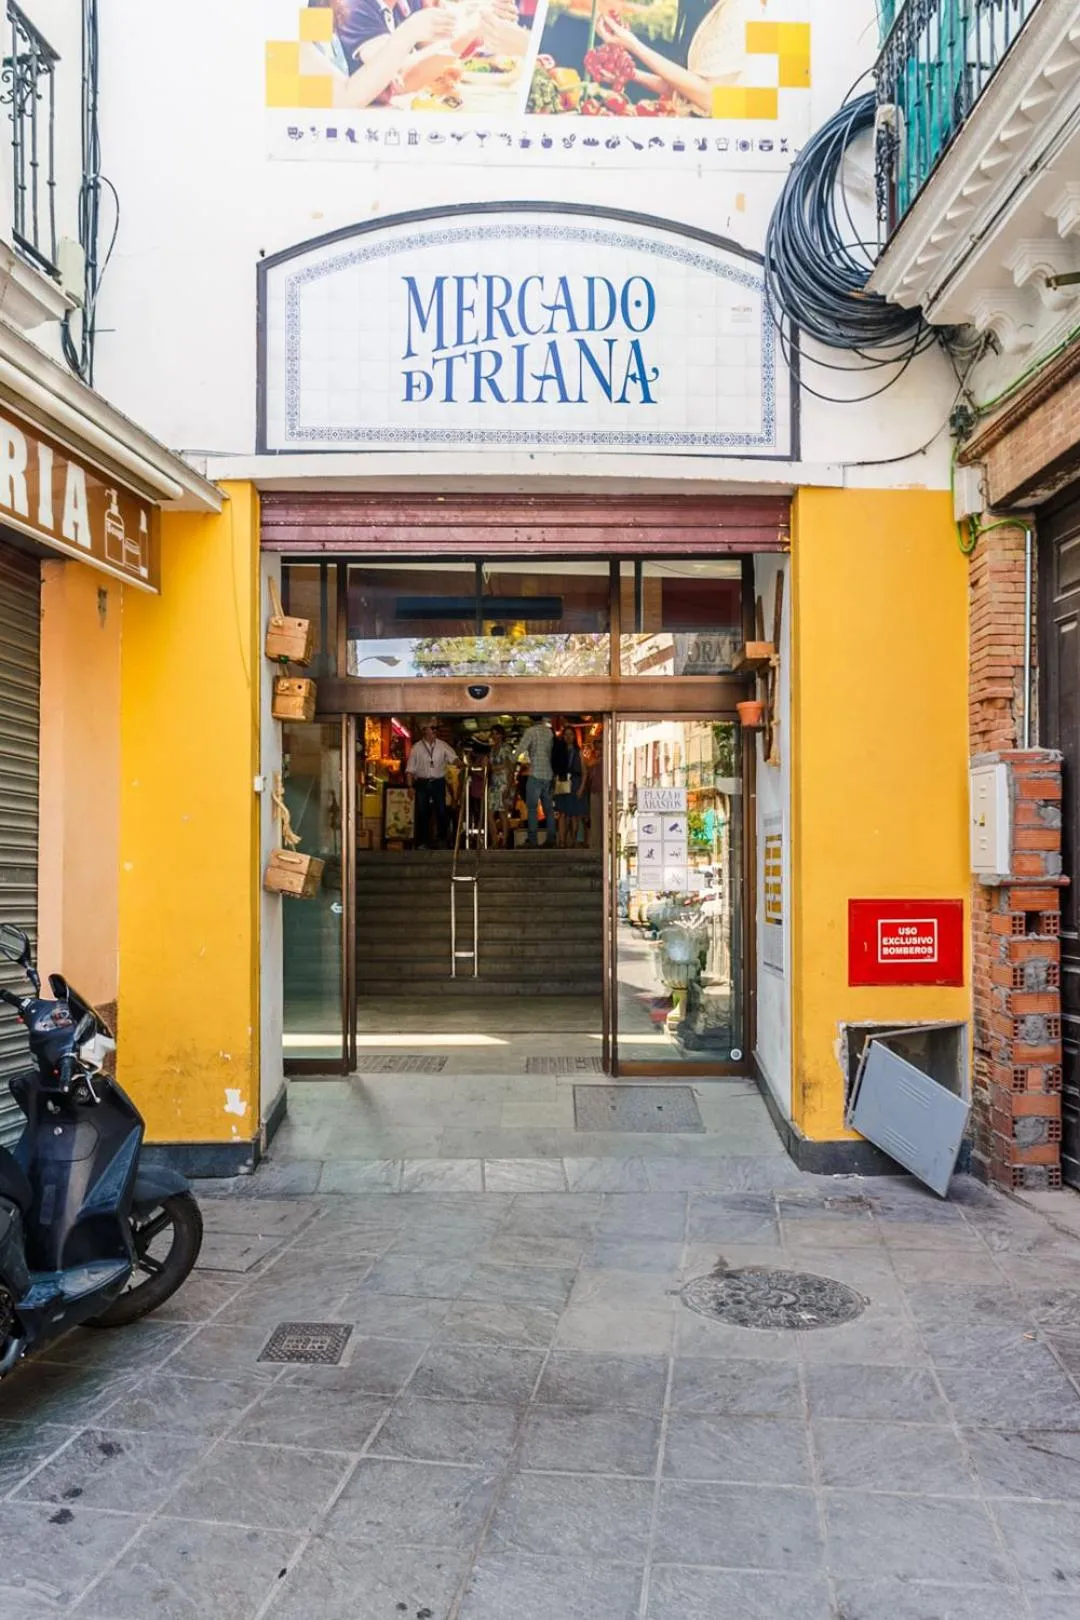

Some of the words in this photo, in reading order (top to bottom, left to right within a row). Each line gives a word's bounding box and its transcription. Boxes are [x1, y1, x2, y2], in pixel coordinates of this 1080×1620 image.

[401, 272, 656, 360] MERCADO
[431, 338, 660, 404] TRIANA
[644, 790, 674, 800] PLAZA
[643, 800, 682, 809] ABASTOS
[898, 926, 918, 936] USO
[882, 936, 934, 946] EXCLUSIVO
[882, 946, 934, 955] BOMBEROS
